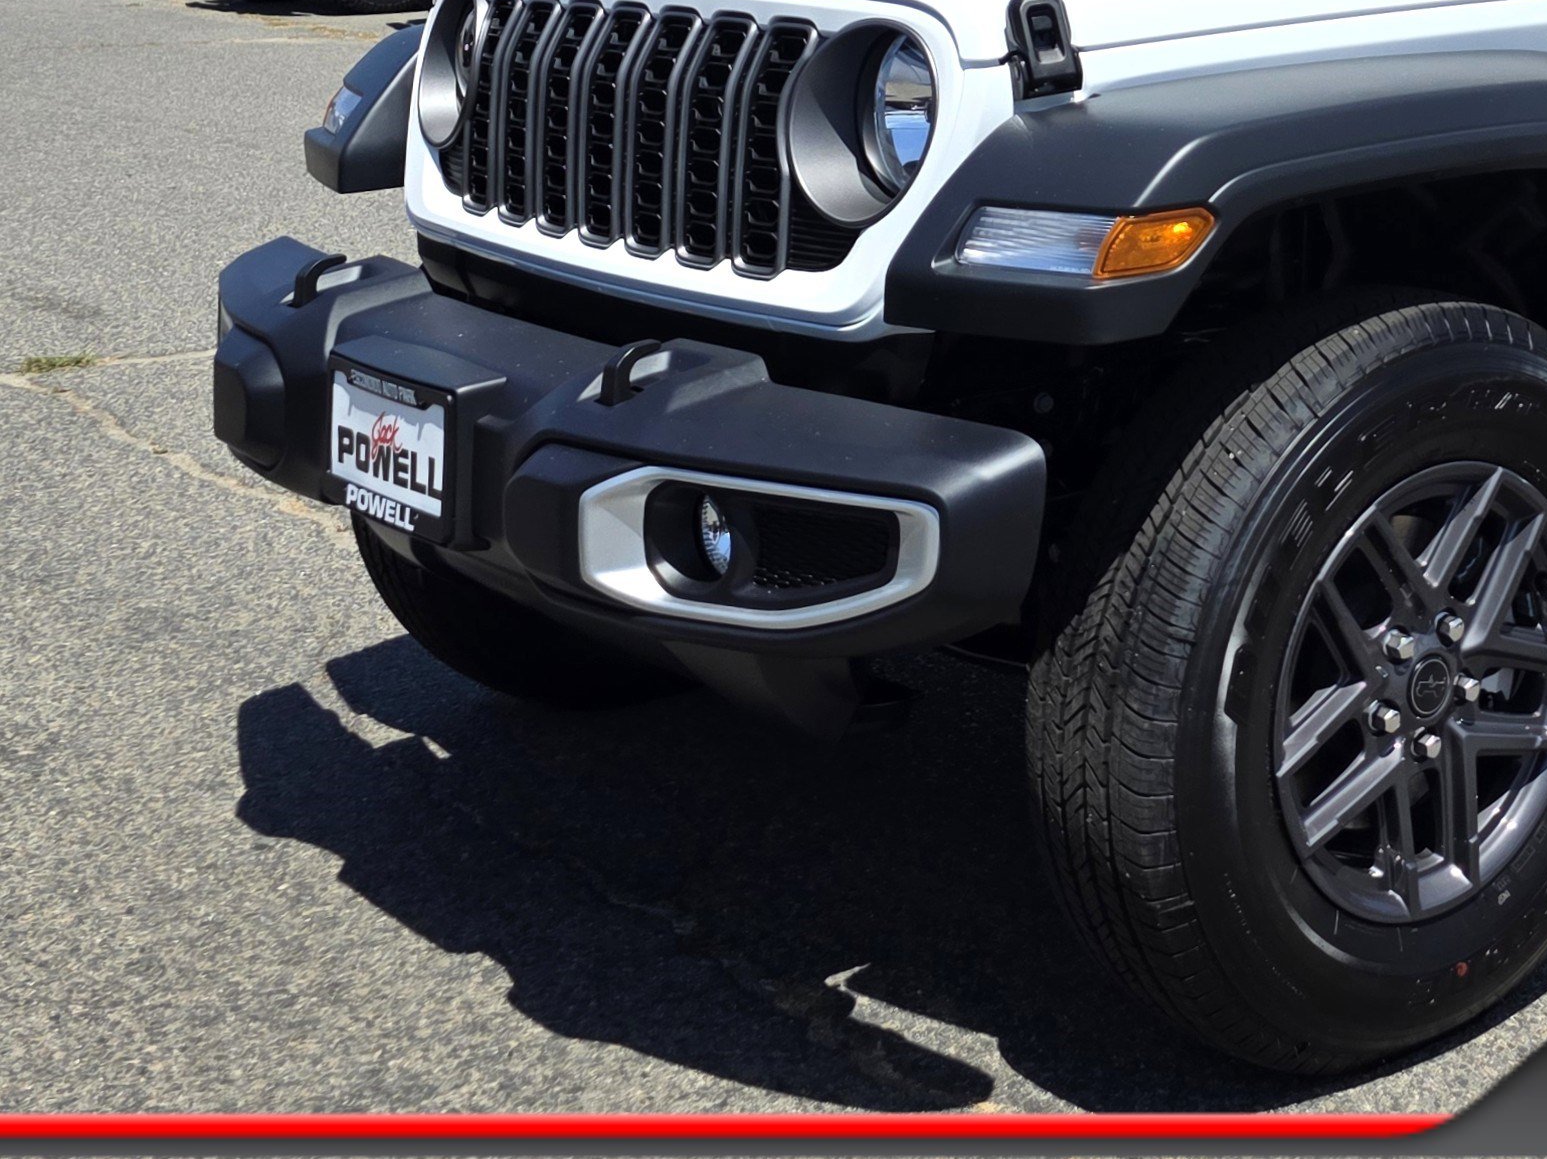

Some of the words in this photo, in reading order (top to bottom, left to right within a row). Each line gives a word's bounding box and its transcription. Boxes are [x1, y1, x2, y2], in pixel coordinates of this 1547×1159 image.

[371, 410, 403, 461] Jack
[337, 424, 443, 500] POWELL
[345, 483, 415, 532] POWELL
